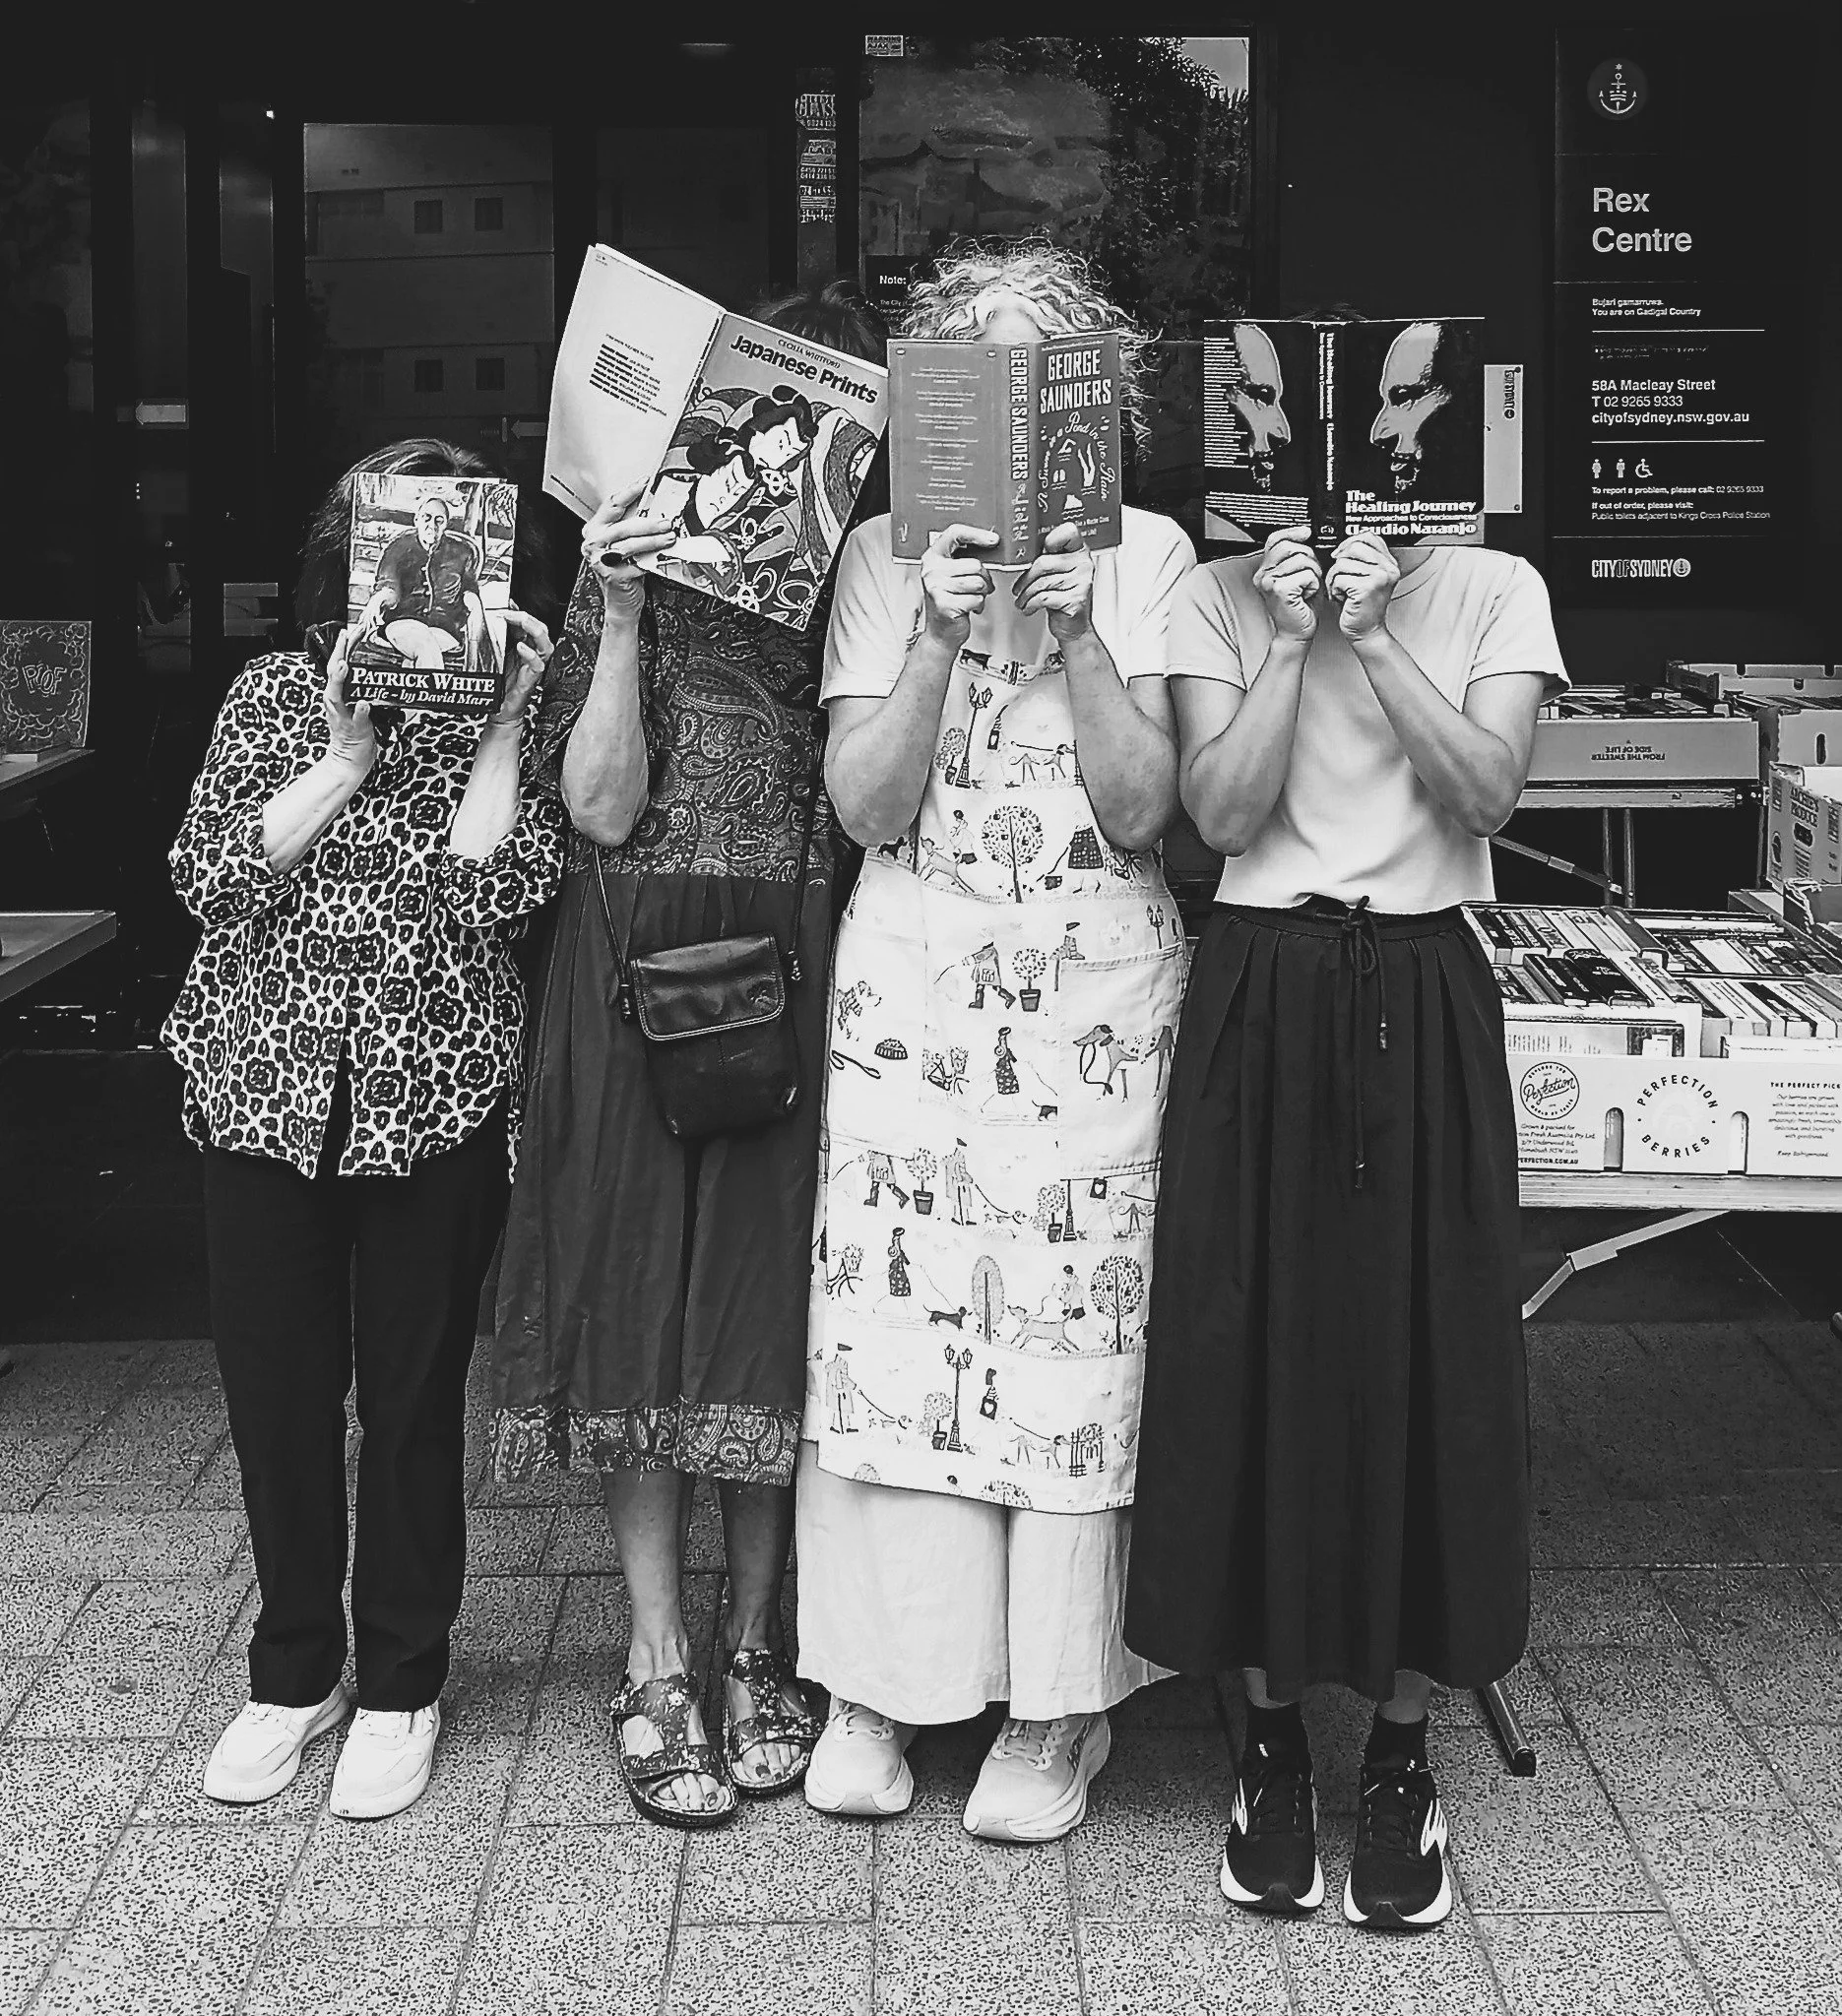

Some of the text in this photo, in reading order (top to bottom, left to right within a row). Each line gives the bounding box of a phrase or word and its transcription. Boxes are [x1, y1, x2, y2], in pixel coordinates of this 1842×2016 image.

[1592, 187, 1650, 212] Rex
[1592, 226, 1692, 252] Centre
[879, 275, 907, 284] Note:
[730, 335, 817, 380] Japanese
[818, 368, 878, 404] Prints
[1048, 348, 1102, 381] GEORGE
[1010, 348, 1028, 404] GEORGE
[1591, 379, 1716, 393] 58A Macleay Street
[1040, 379, 1112, 414] SAUNDERS
[1591, 396, 1683, 408] T 02 9265 9333
[1591, 411, 1750, 426] cityofsydney.nsw.gov.au
[1011, 407, 1029, 481] SAUNDERS
[1100, 462, 1115, 502] Rain
[1635, 486, 1670, 495] problem,
[1671, 486, 1696, 495] please
[1345, 489, 1376, 502] The
[1345, 500, 1477, 515] Healing Journey
[1363, 514, 1409, 523] Approaches
[1637, 512, 1669, 521] adjacent
[1678, 512, 1698, 521] Kings
[1345, 522, 1477, 536] Claudio Naranjo
[350, 666, 495, 693] PATRICK WHITE
[349, 686, 362, 698] A
[363, 686, 389, 700] Life
[399, 688, 416, 703] by
[415, 689, 456, 705] David
[456, 693, 494, 706] Marr
[1636, 1074, 1719, 1108] PERFECTION
[1641, 1134, 1710, 1158] BERRIES
